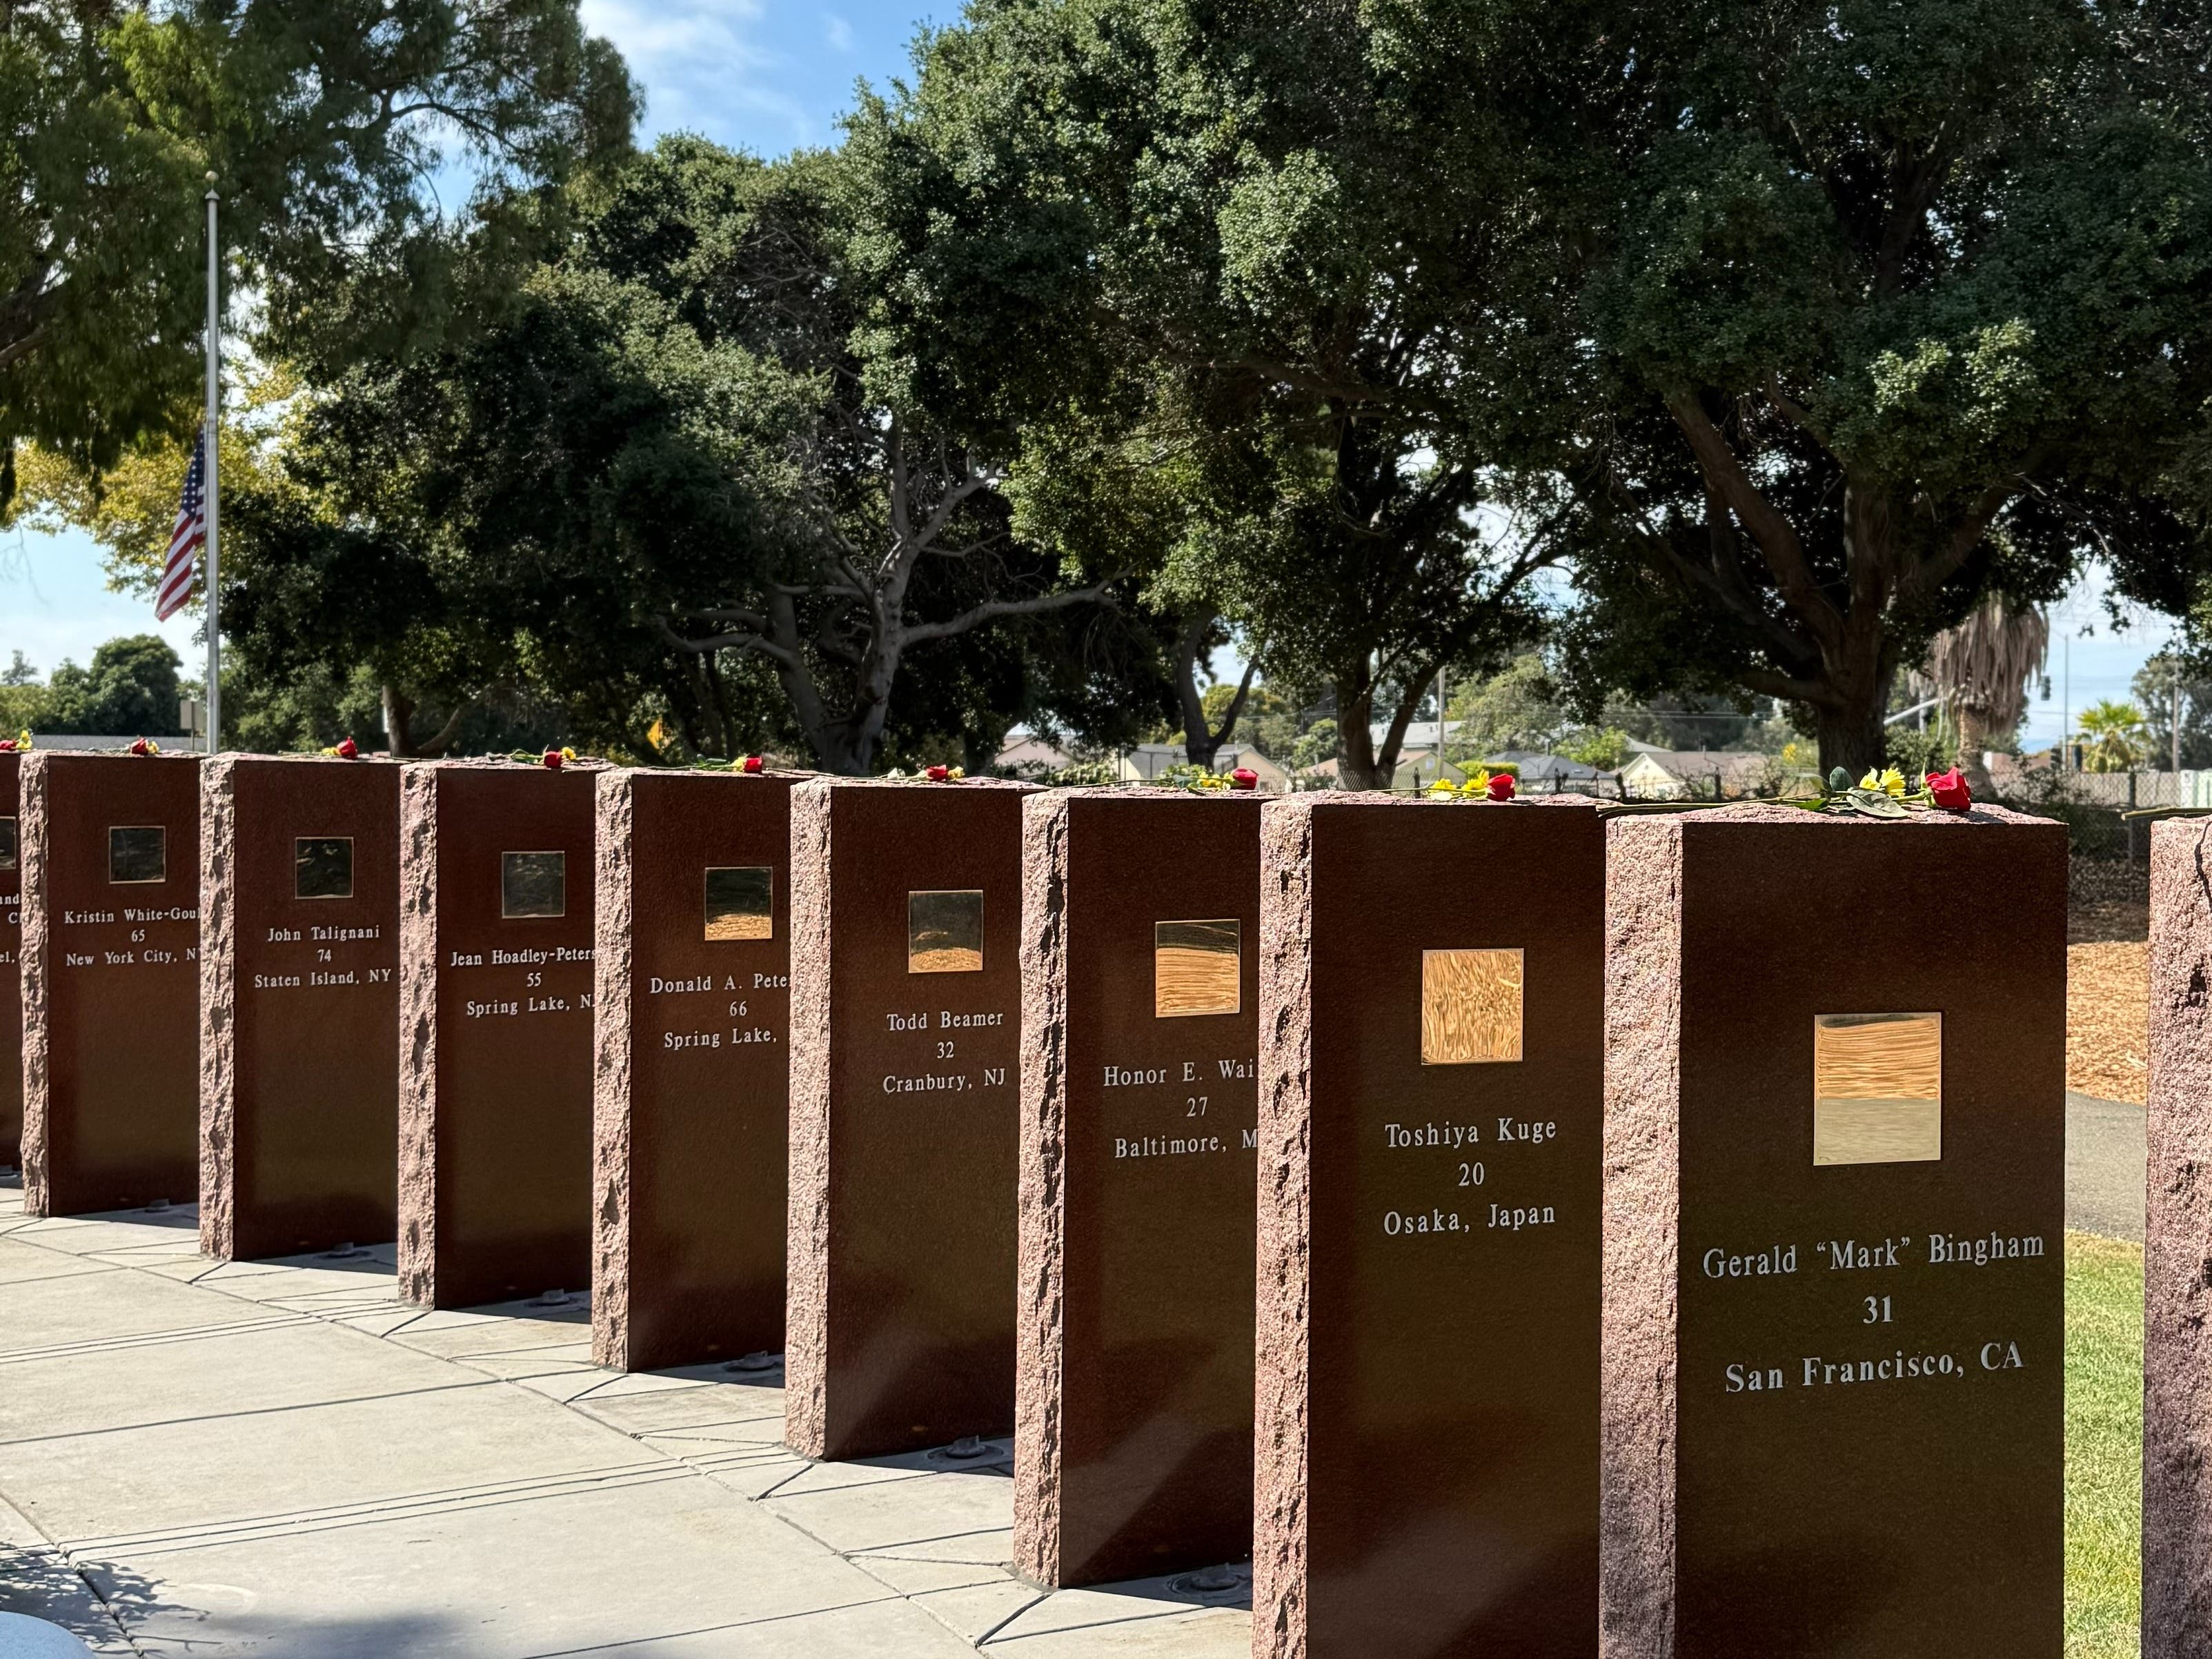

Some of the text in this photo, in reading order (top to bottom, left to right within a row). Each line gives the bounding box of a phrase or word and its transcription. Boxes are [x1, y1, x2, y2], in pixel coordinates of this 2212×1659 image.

[64, 910, 115, 924] Kristin
[131, 929, 145, 942] 65
[268, 924, 379, 942] John Talignani
[66, 947, 200, 966] New York City, N
[317, 948, 332, 962] 74
[451, 951, 482, 966] Jean
[255, 968, 391, 988] Staten Island, NY
[526, 972, 542, 987] 55
[650, 973, 790, 993] Donald A. Pete
[466, 993, 595, 1018] Spring Lake, N
[729, 1000, 747, 1017] 66
[886, 1011, 1003, 1031] Todd Beamer
[664, 1027, 777, 1051] Spring Lake,
[937, 1041, 954, 1059] 32
[883, 1068, 1005, 1095] Cranbury, NJ
[1103, 1066, 1167, 1086] Honor
[1182, 1062, 1203, 1082] E.
[1186, 1096, 1208, 1117] 27
[1385, 1117, 1556, 1149] Toshiya Kuge
[1114, 1135, 1227, 1158] Baltimore,
[1458, 1162, 1485, 1186] 20
[1383, 1204, 1555, 1235] Osaka, Japan
[1703, 1231, 2045, 1278] Gerald “Mark” Bingham
[1863, 1295, 1893, 1324] 31
[1726, 1341, 2023, 1393] San Francisco, CA
